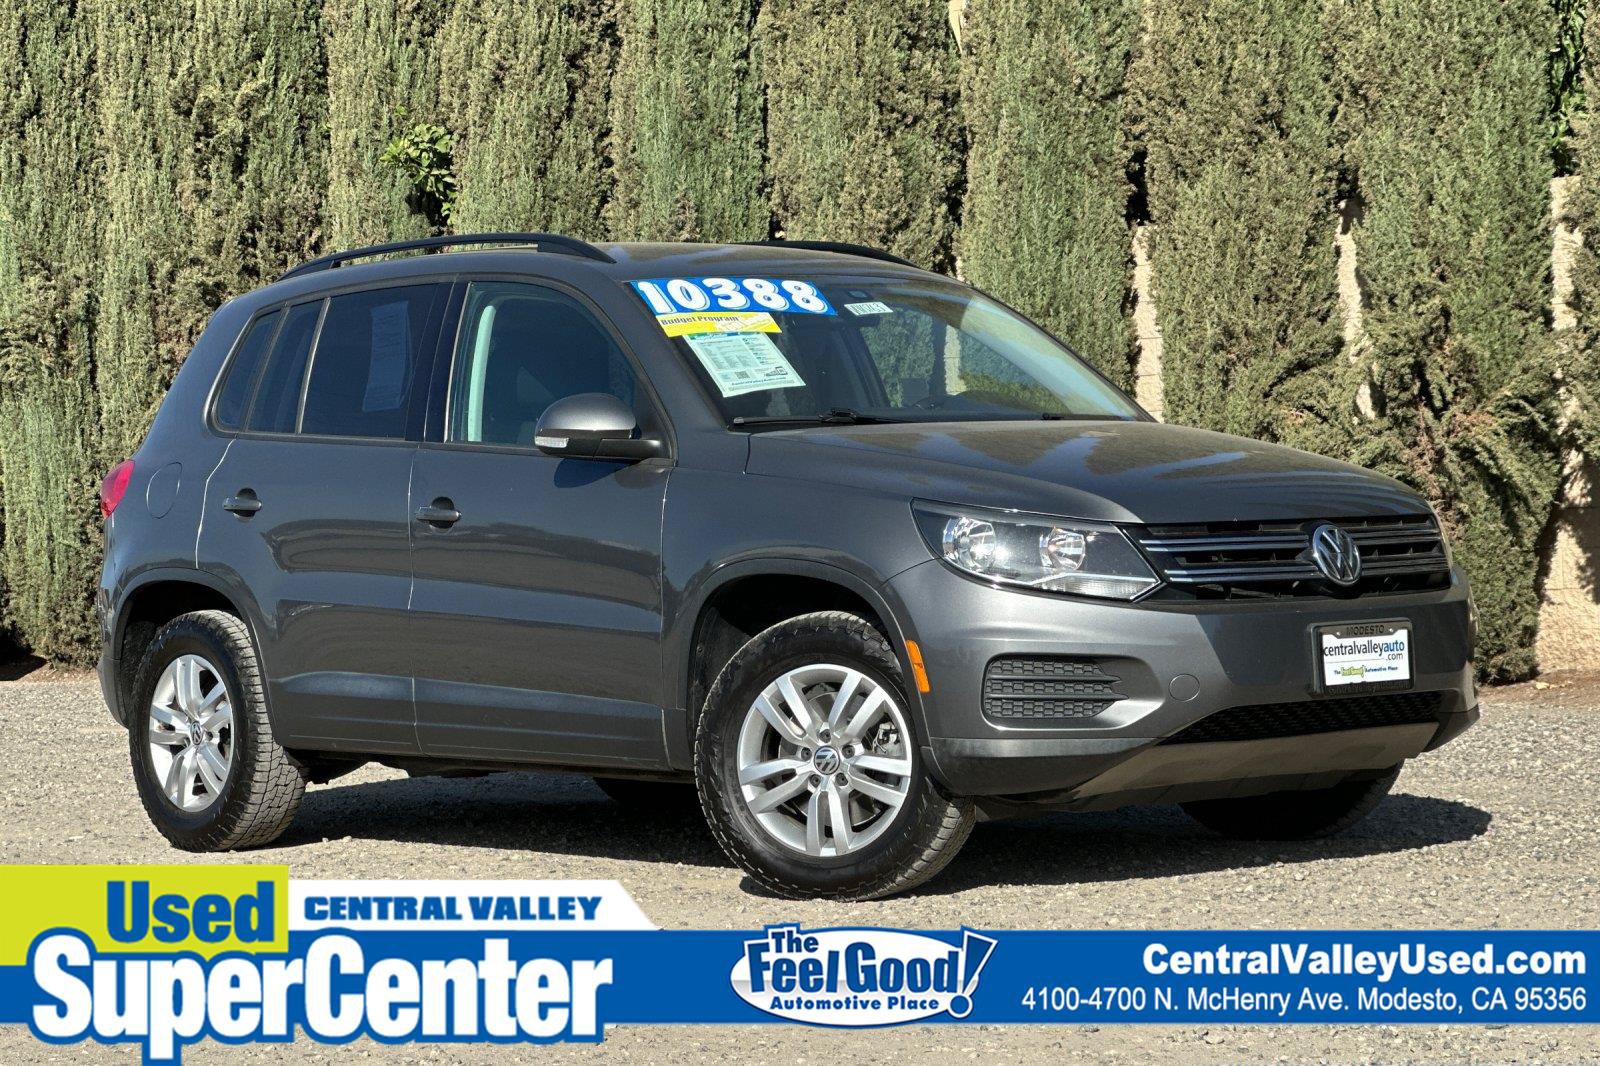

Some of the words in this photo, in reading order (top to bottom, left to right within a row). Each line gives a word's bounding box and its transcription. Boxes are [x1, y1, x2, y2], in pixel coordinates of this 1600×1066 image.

[637, 277, 829, 314] 10388
[661, 315, 696, 325] Budget
[697, 315, 739, 324] Program
[1346, 624, 1385, 636] MODESTO
[1323, 639, 1405, 657] centralvalleyauto
